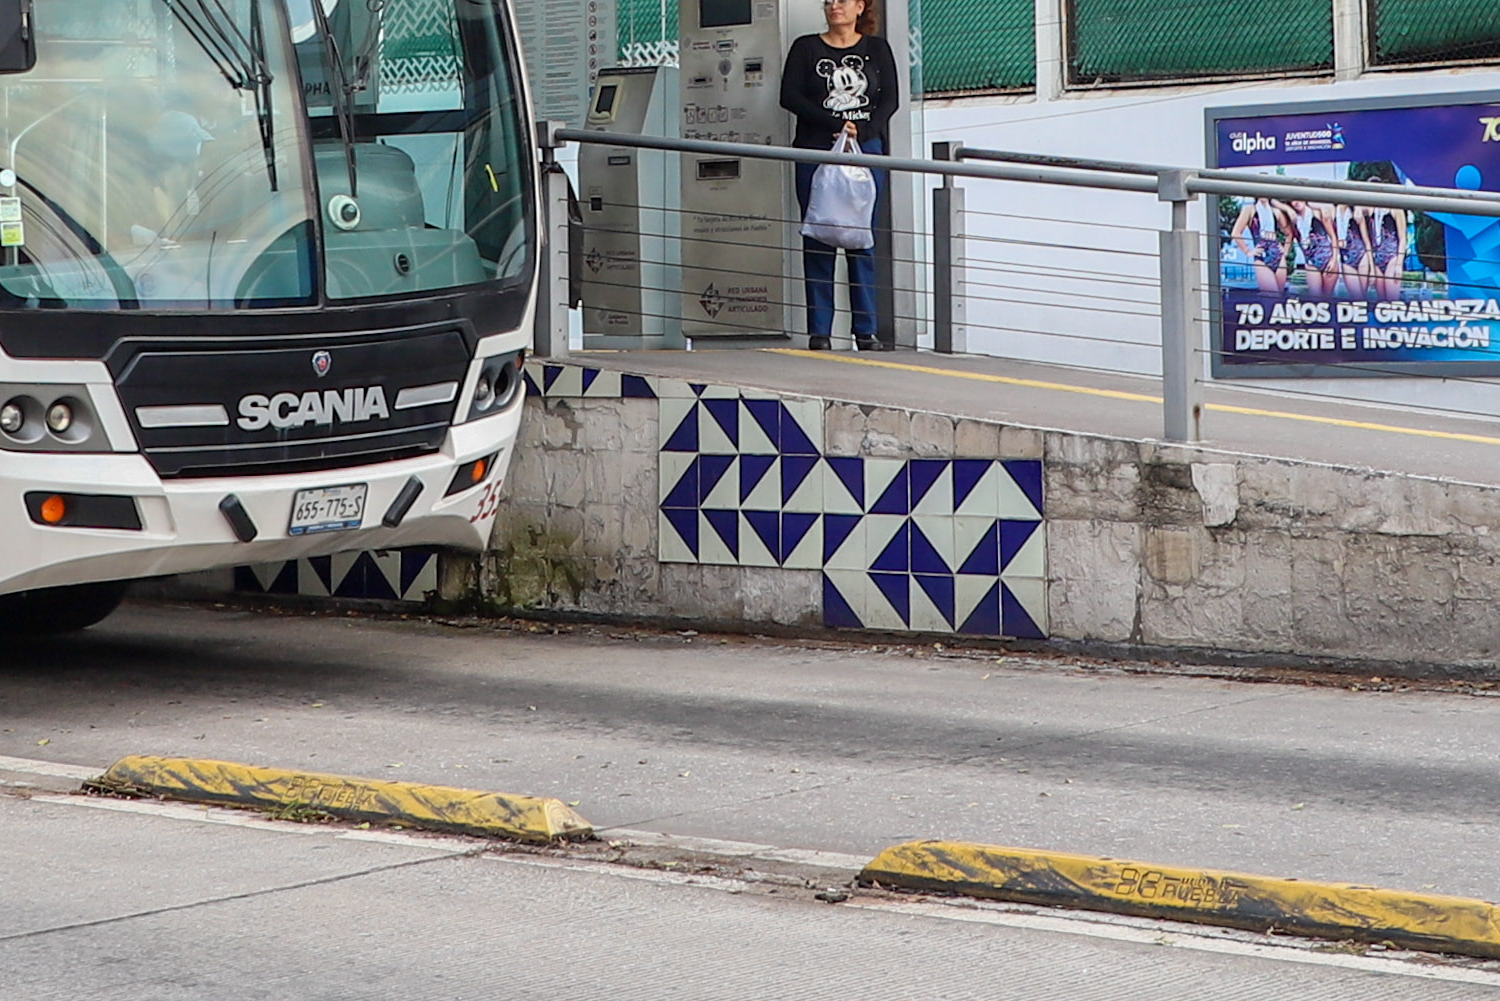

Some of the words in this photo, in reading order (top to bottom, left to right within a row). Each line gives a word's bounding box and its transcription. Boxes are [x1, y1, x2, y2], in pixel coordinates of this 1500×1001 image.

[842, 109, 870, 121] Mickey
[1233, 132, 1276, 155] alpha
[1235, 303, 1263, 325] 70
[1269, 298, 1331, 325] AÑOS
[1337, 302, 1368, 323] DE
[1235, 328, 1335, 351] DEPORTE
[1341, 328, 1356, 349] E
[1363, 320, 1490, 349] INOVACIÓN
[236, 385, 389, 431] SCANIA
[296, 495, 362, 521] 655-775-S
